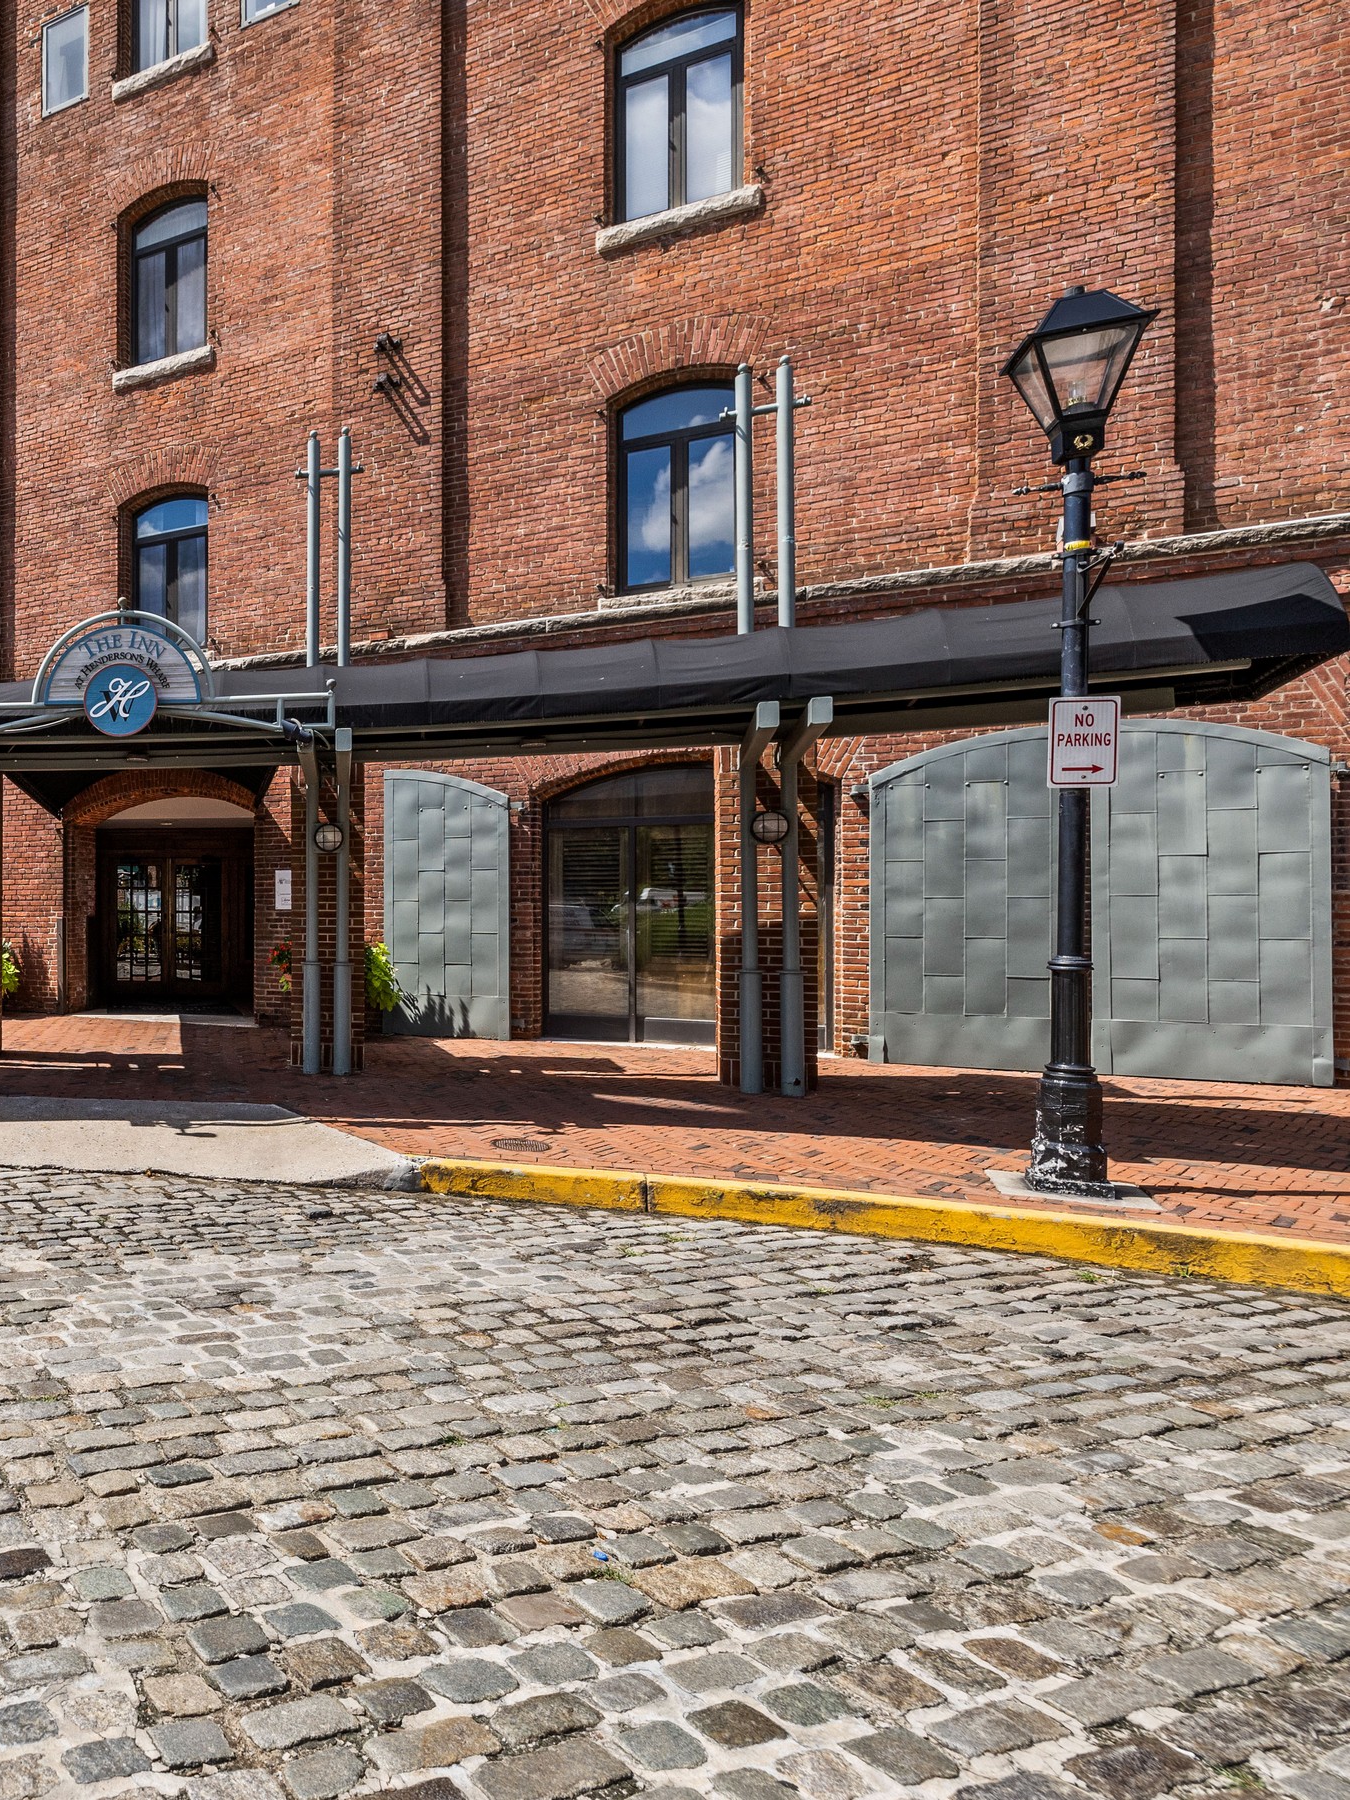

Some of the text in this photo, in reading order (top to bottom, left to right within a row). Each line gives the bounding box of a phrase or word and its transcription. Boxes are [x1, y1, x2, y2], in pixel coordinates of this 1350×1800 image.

[78, 630, 167, 660] THE INN
[74, 651, 171, 690] AT HENDERSON'S WHARF
[1074, 713, 1095, 728] NO
[1057, 732, 1112, 747] PARKING
